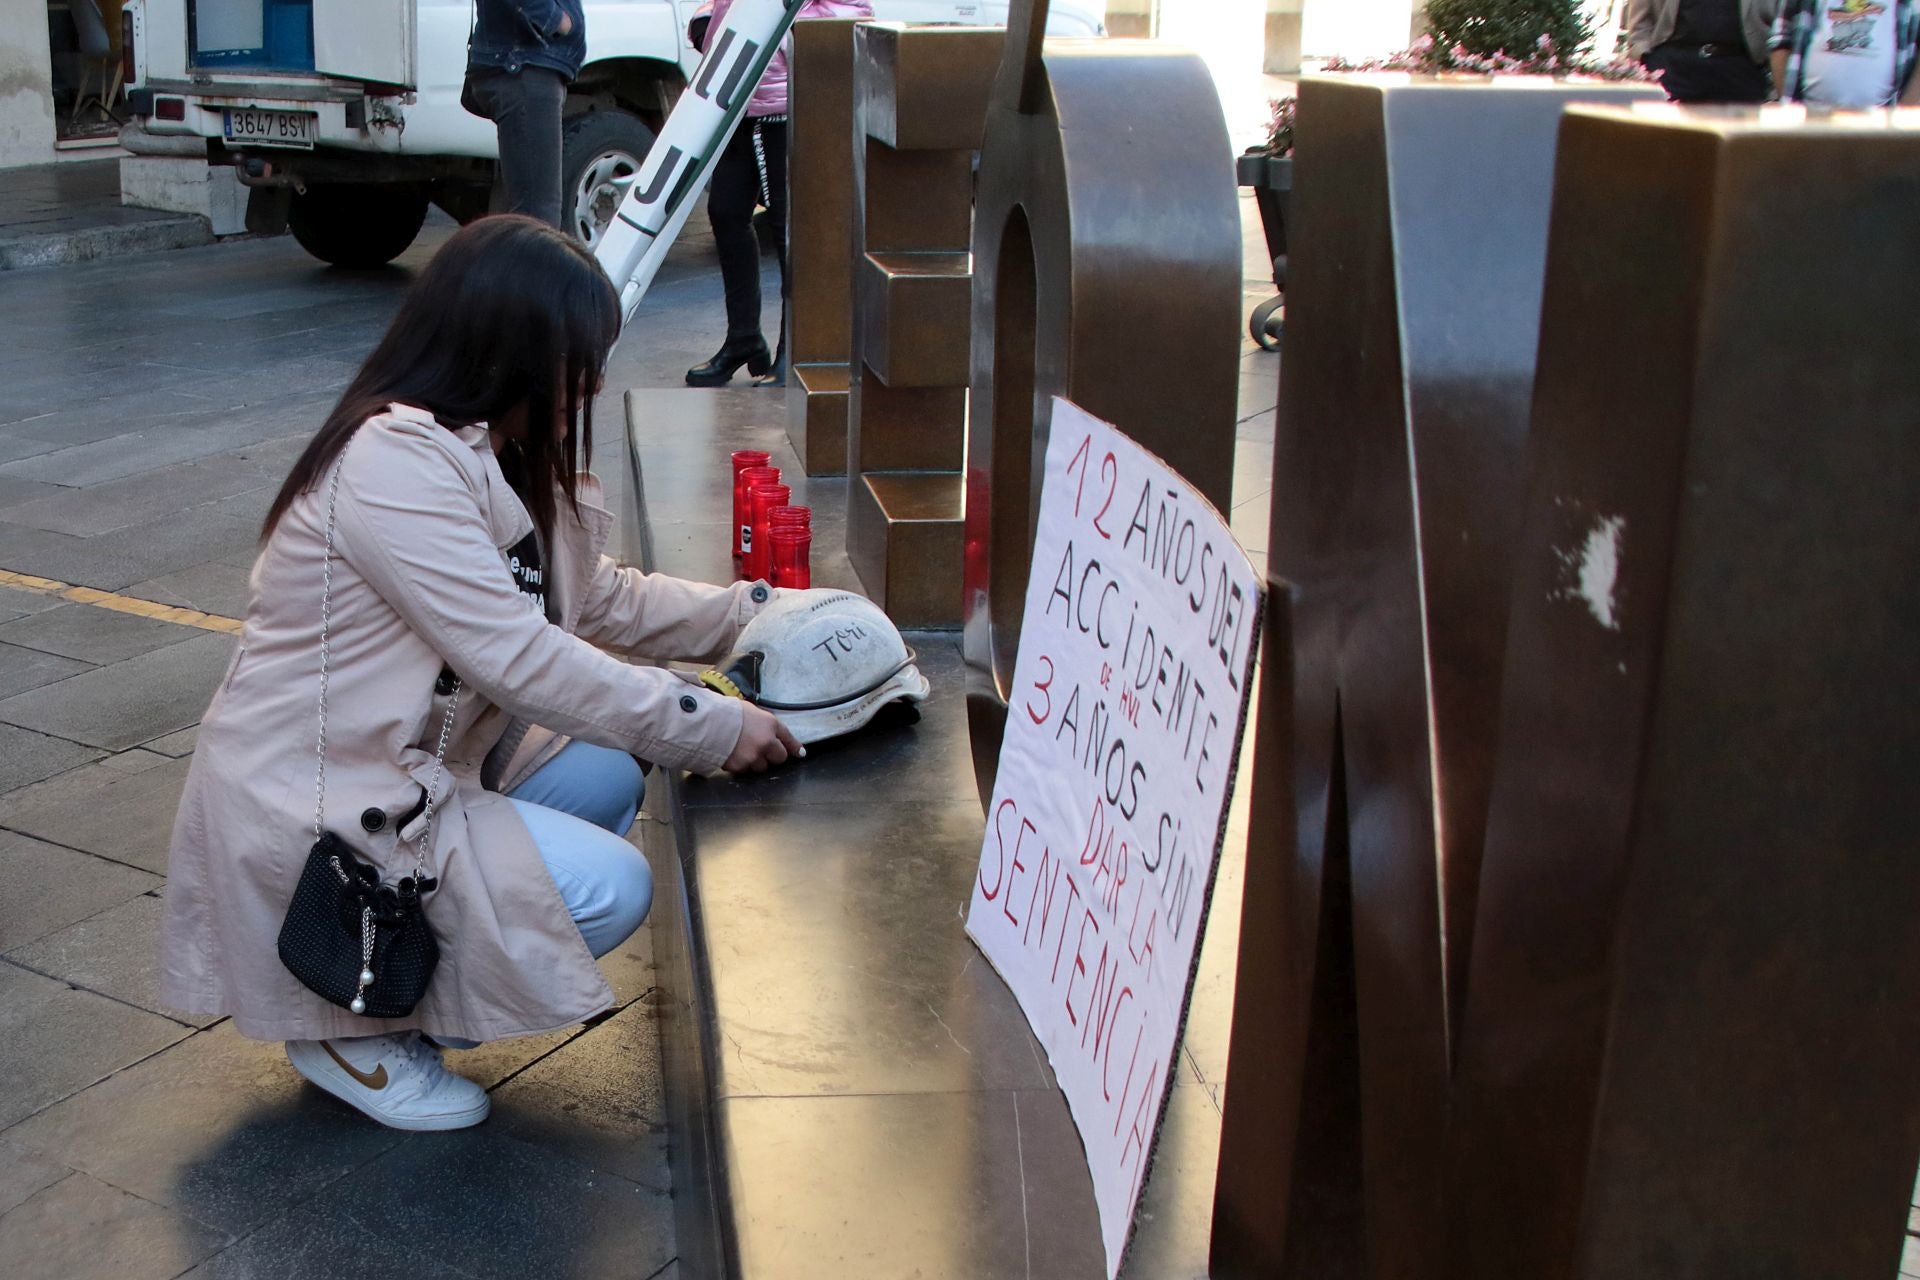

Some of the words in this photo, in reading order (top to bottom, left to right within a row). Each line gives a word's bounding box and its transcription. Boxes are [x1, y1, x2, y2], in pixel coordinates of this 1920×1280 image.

[234, 112, 273, 136] 3647
[278, 114, 306, 138] BSV
[1067, 434, 1118, 540] 12
[1123, 478, 1213, 613] AÑOS
[1208, 560, 1245, 693] DEL
[1027, 655, 1054, 725] 3
[1056, 684, 1146, 821] AÑOS
[1100, 661, 1112, 692] DE
[1119, 680, 1141, 729] HVL
[1080, 794, 1128, 926] DAR
[1128, 878, 1156, 984] LA
